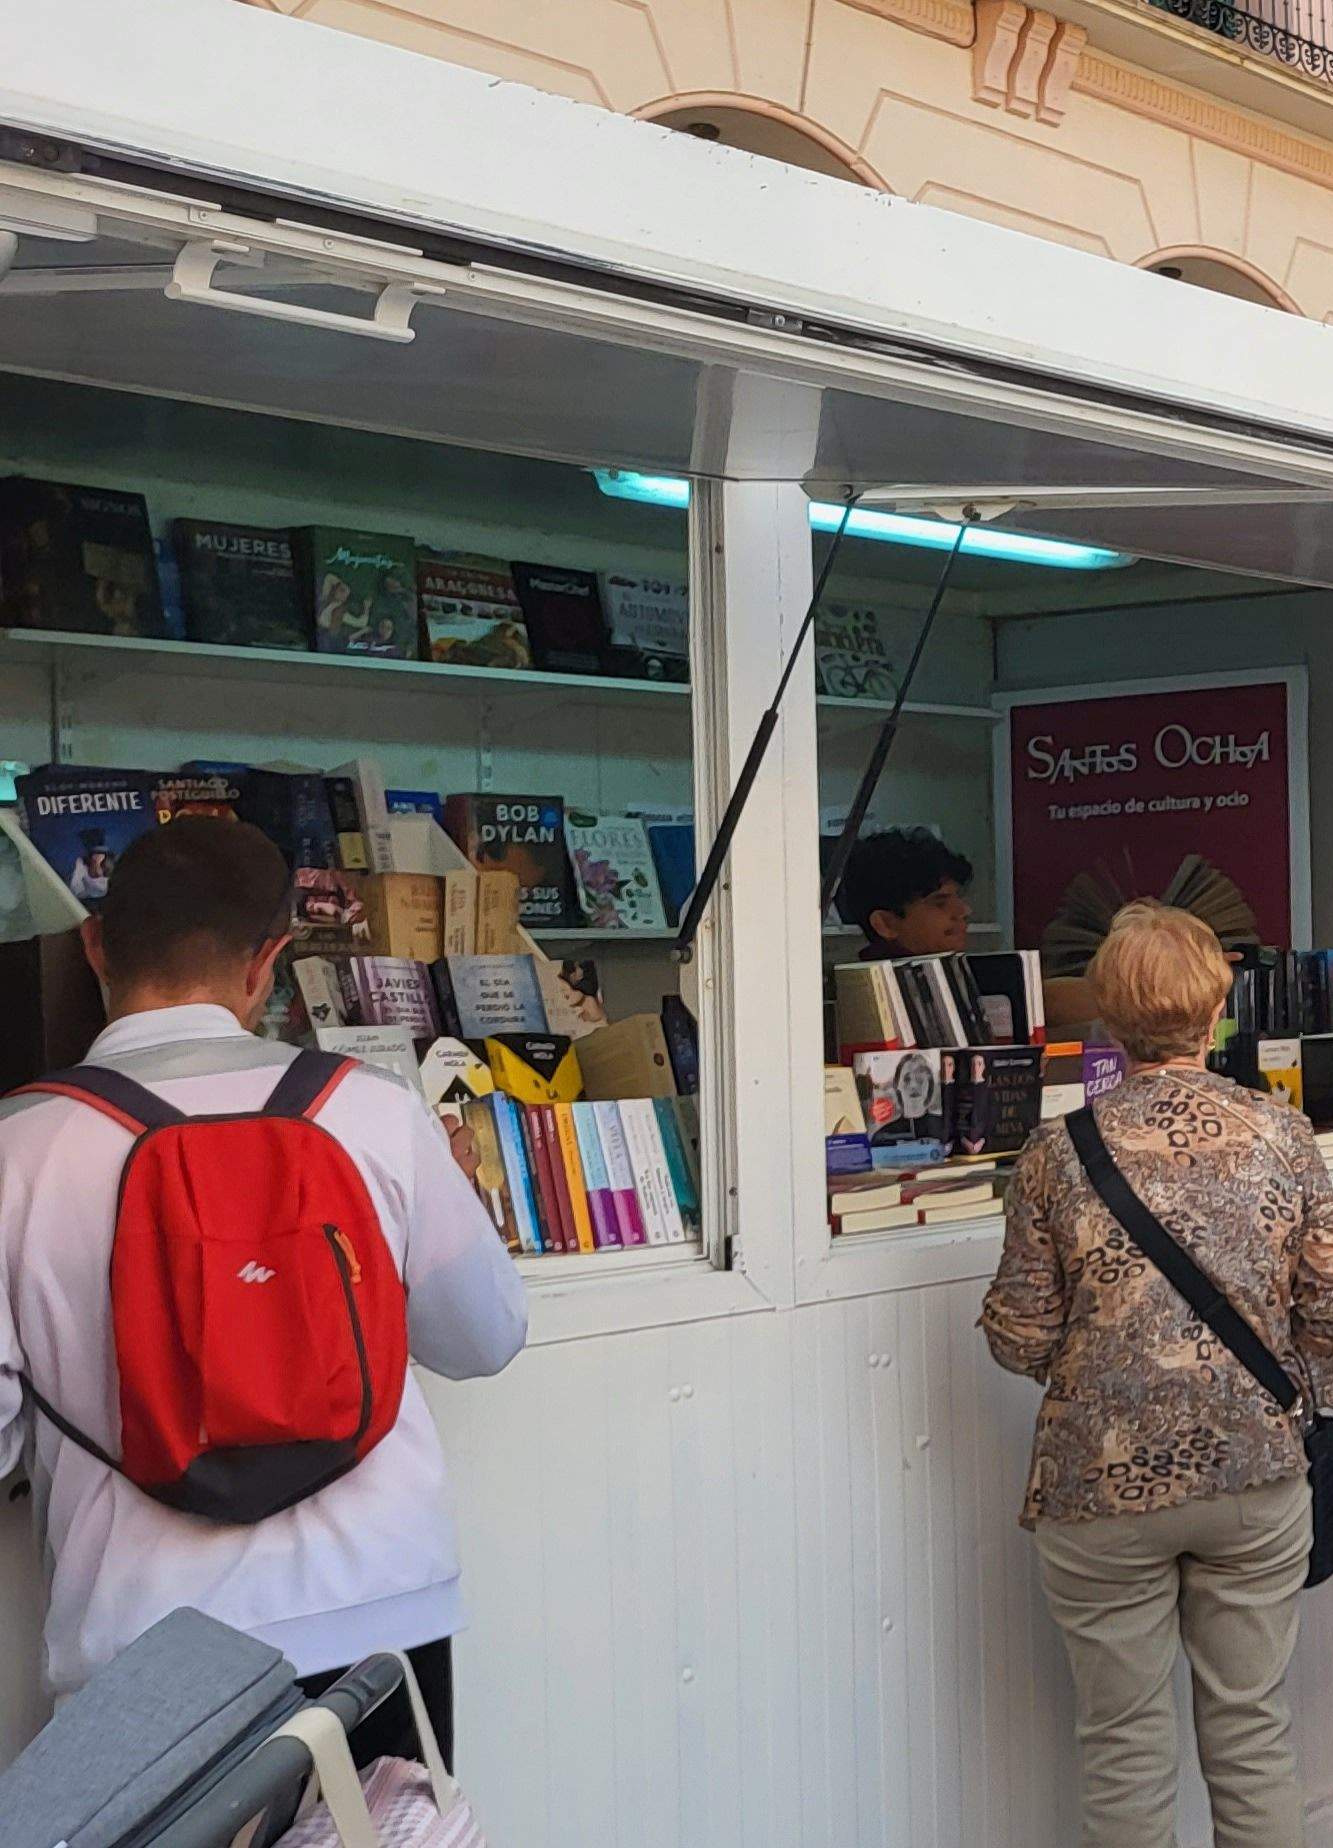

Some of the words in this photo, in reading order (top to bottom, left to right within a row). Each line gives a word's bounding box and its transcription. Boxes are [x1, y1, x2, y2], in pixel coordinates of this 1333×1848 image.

[195, 533, 292, 558] MUJERES
[157, 778, 228, 790] SANTIAGO
[37, 790, 144, 816] DIFERENTE
[495, 804, 540, 822] BOB
[1048, 804, 1066, 821] Tu
[1068, 800, 1121, 821] espacio
[1125, 797, 1145, 814] de
[1148, 795, 1201, 814] cultura
[1204, 796, 1214, 813] y
[1216, 791, 1249, 807] ocio
[481, 825, 555, 843] DYLAN
[532, 886, 559, 899] SUS
[1091, 1056, 1118, 1077] TAN
[1086, 1071, 1123, 1097] CERCA
